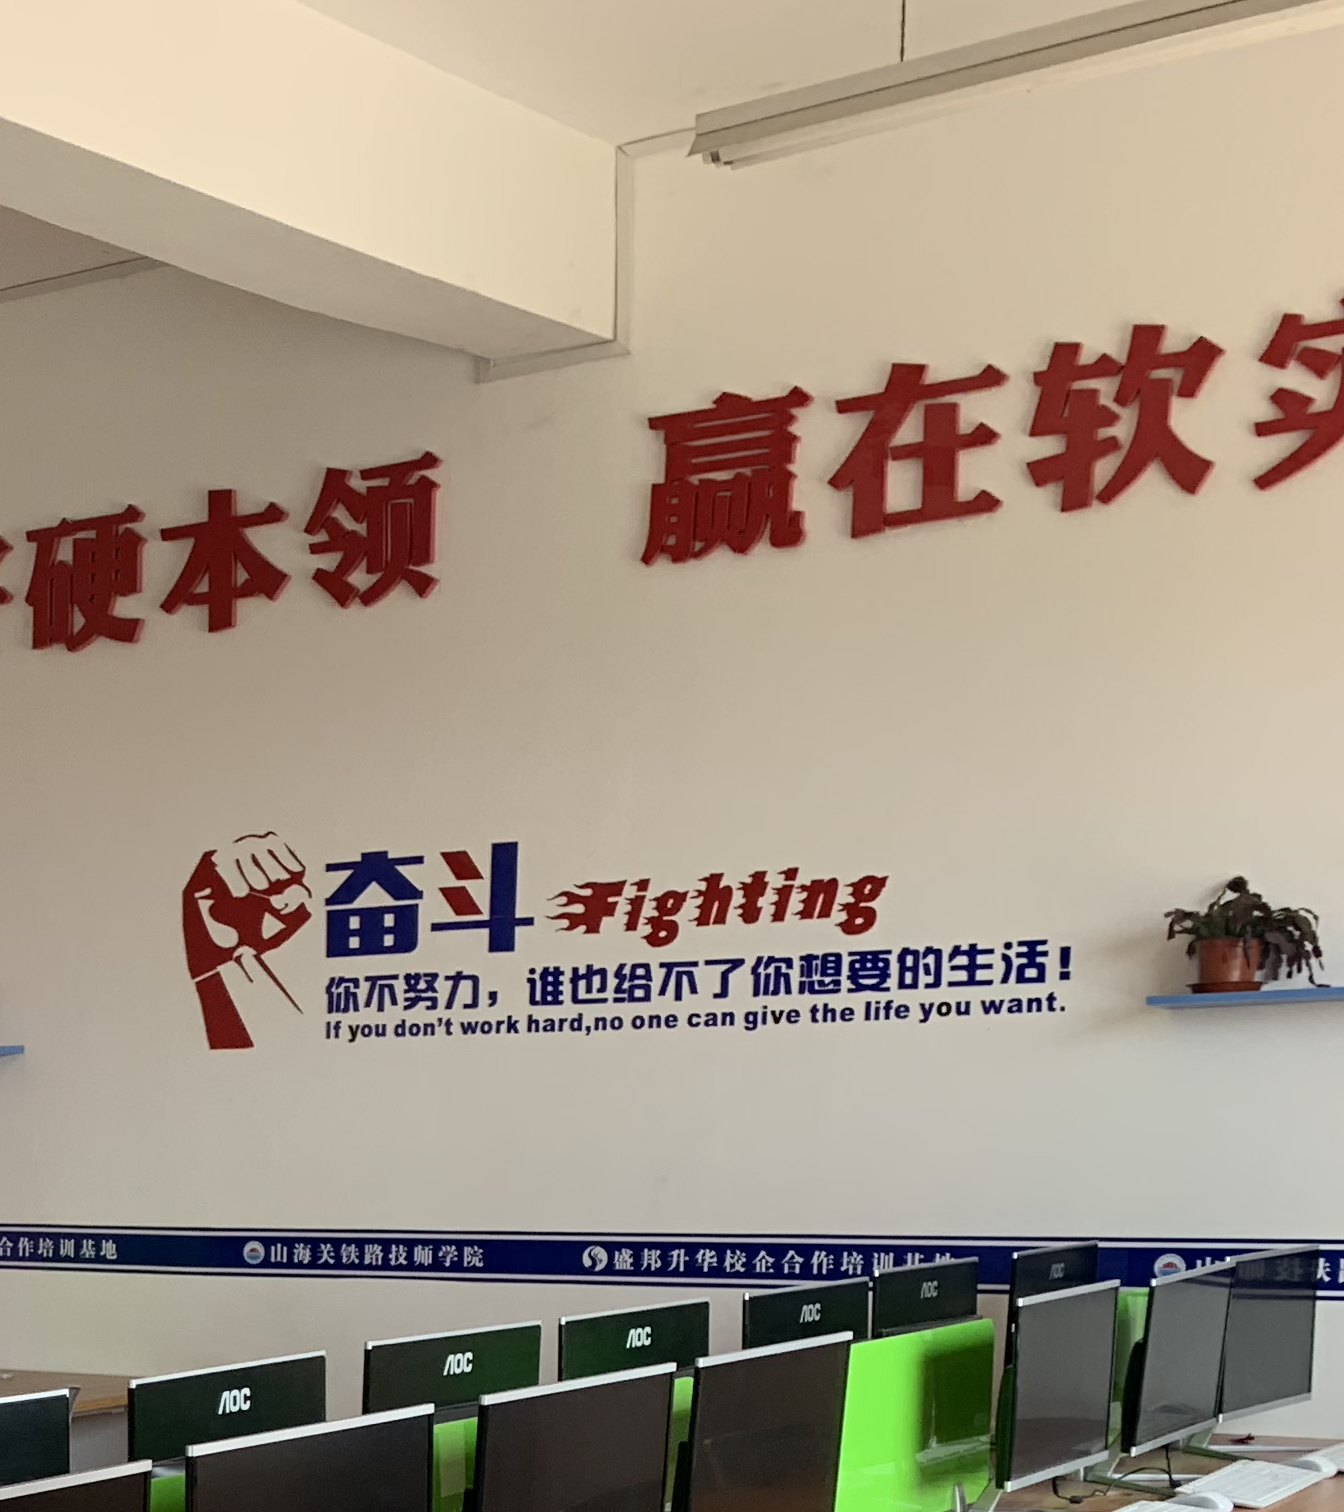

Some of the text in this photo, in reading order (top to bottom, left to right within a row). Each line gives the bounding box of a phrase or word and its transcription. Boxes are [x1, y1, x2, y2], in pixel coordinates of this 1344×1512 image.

[325, 841, 534, 958] 奋斗
[547, 866, 889, 948] Fighting
[326, 1020, 339, 1039] If
[347, 1022, 387, 1042] you
[394, 1018, 453, 1038] don't
[461, 1015, 520, 1036] work
[632, 1012, 679, 1030] one
[687, 1011, 735, 1028] can
[744, 1005, 801, 1031] give
[810, 1002, 855, 1023] the
[864, 999, 911, 1021] life
[919, 999, 971, 1023] you
[981, 992, 1067, 1016] want.
[270, 1242, 484, 1268] 山海关铁路技师学院
[920, 1280, 939, 1299] AOC
[799, 1302, 821, 1323] AOC
[626, 1326, 652, 1349] AOC
[443, 1351, 473, 1376] AOC
[217, 1387, 251, 1415] AOC
